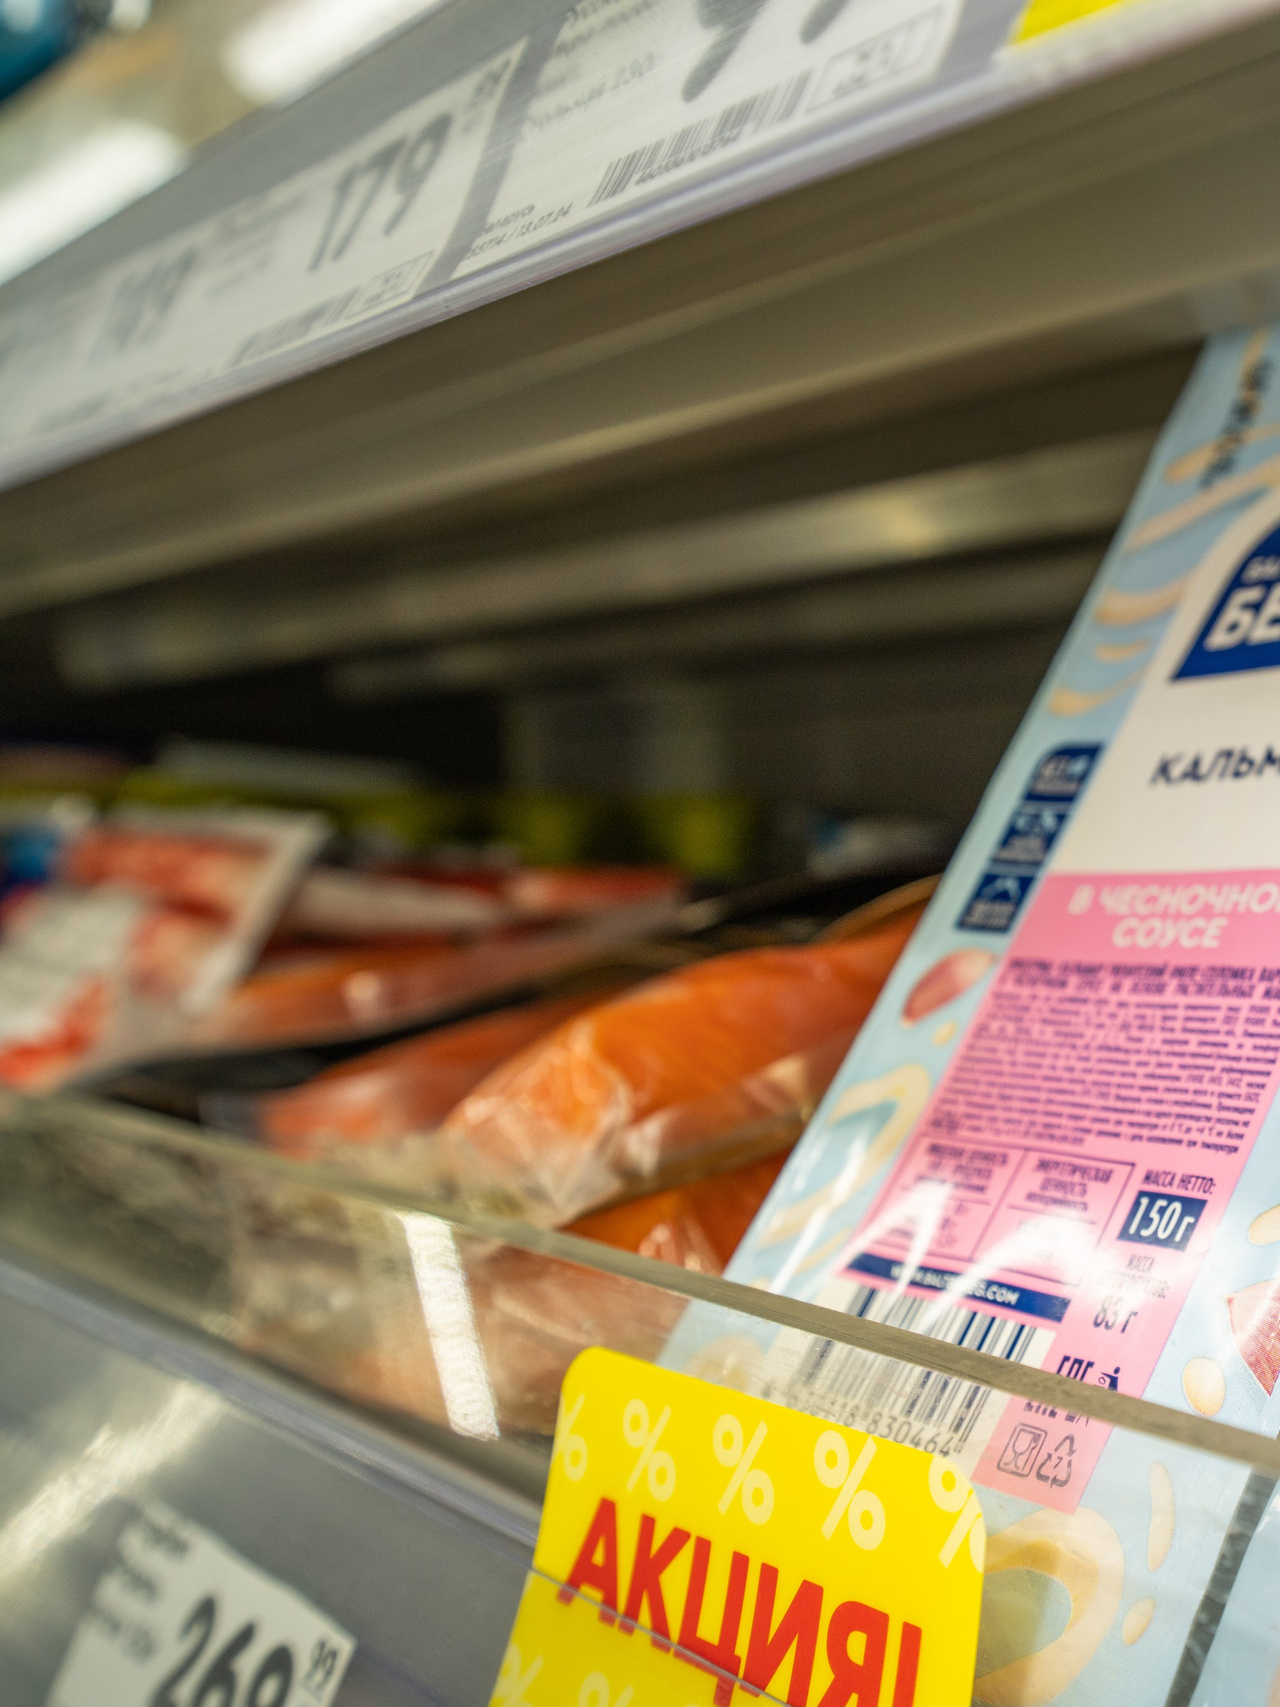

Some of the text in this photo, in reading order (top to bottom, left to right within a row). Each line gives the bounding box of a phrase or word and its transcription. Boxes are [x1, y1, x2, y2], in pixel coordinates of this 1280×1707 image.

[308, 113, 454, 274] 179
[1067, 884, 1096, 915] В
[1112, 916, 1228, 948] СОУСЕ
[1142, 1169, 1217, 1195] МАССА НЕТТО:
